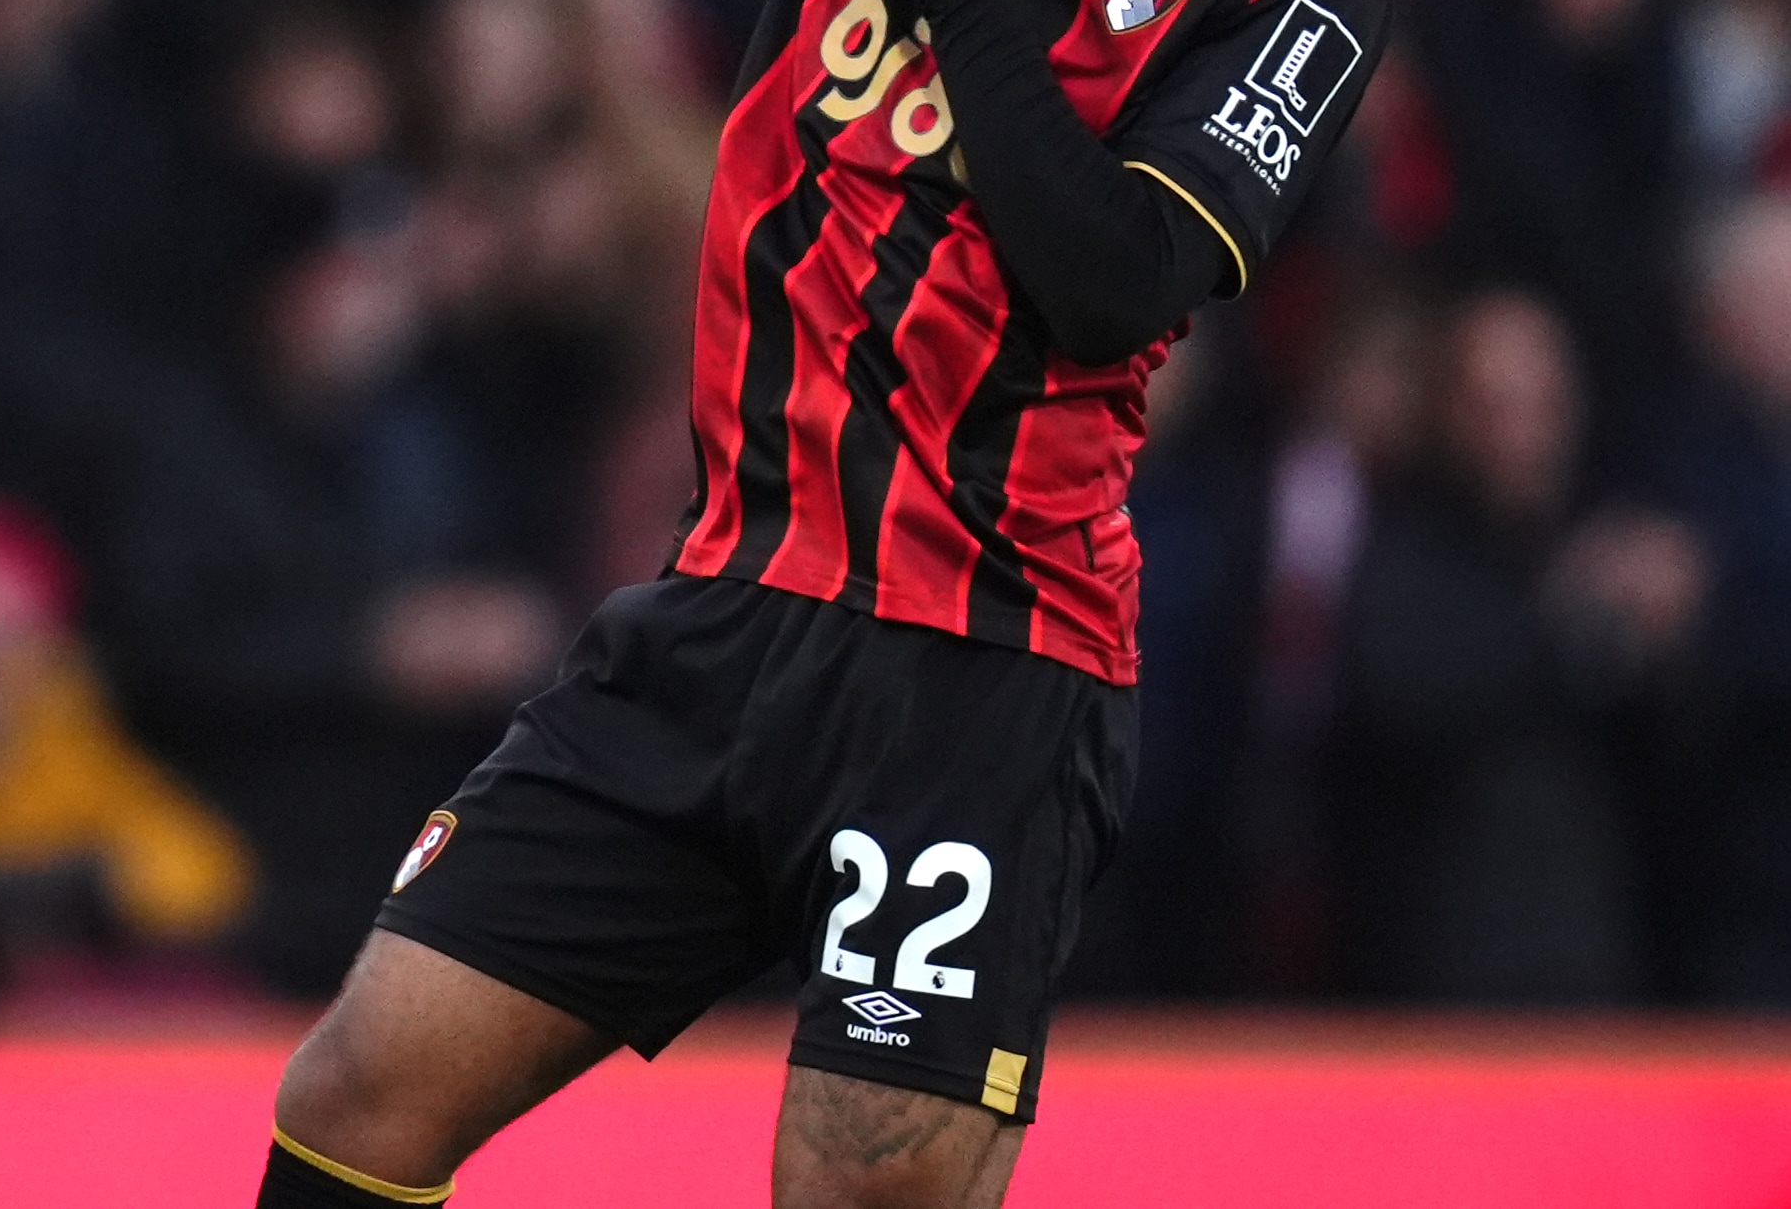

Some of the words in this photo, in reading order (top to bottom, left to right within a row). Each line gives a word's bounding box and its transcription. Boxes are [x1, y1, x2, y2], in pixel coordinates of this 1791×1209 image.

[1210, 86, 1301, 180] LEOS
[821, 829, 992, 999] 22
[846, 1022, 910, 1047] umbro
